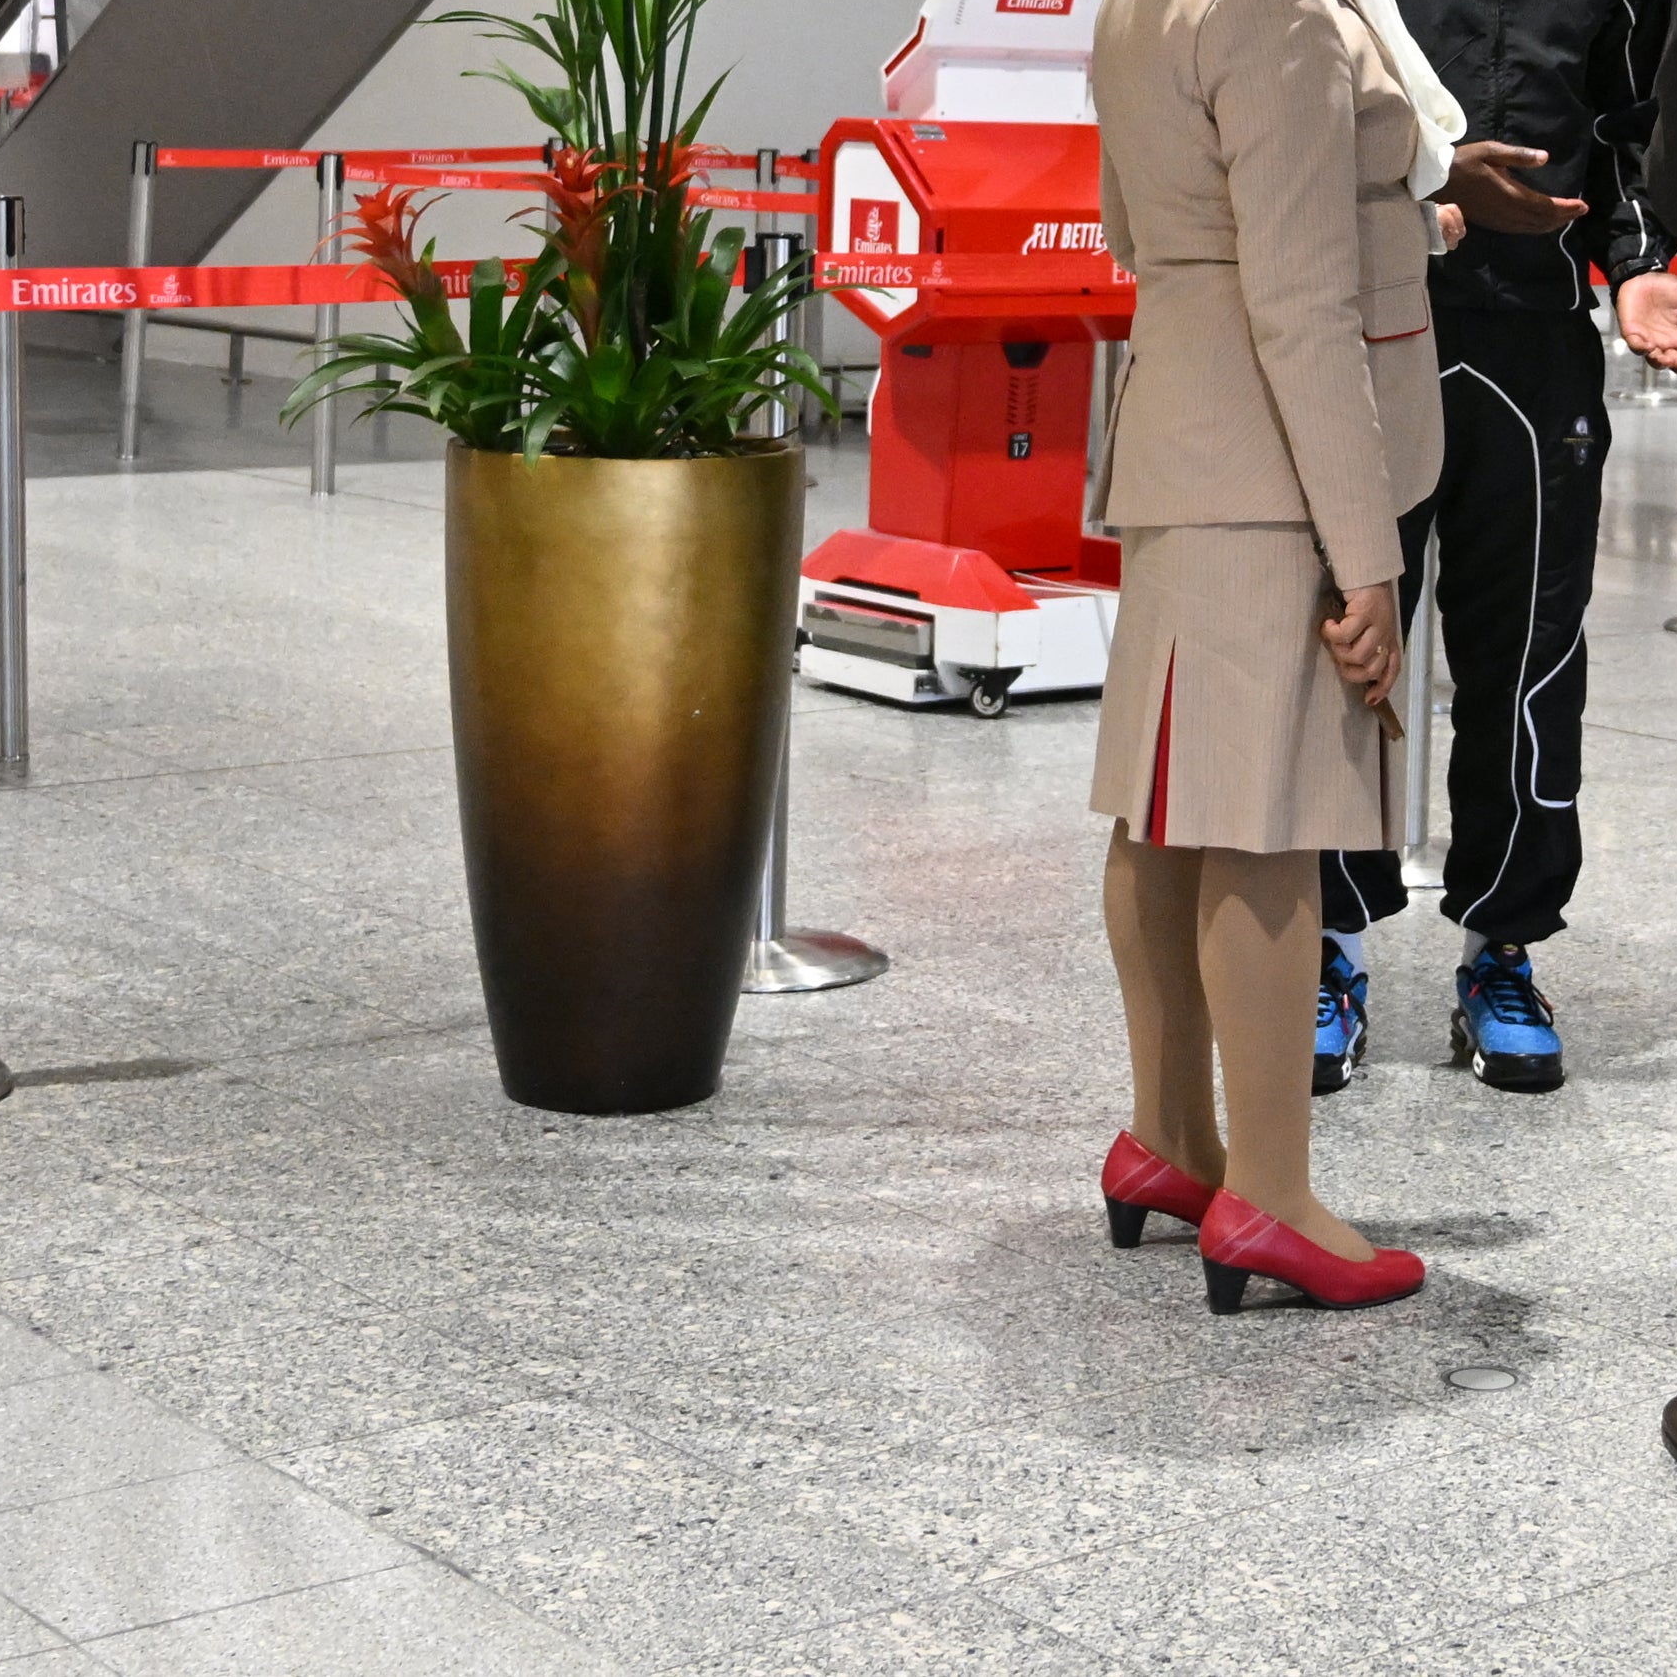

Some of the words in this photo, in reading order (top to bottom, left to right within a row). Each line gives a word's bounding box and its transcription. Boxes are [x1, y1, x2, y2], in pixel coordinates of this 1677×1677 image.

[263, 153, 310, 166] Emirates
[411, 152, 455, 163] Emirates
[694, 157, 728, 167] mirates
[854, 237, 893, 254] Emirates
[1022, 222, 1059, 255] FLY
[1060, 222, 1107, 249] BETTE
[822, 260, 913, 284] Emirates
[12, 277, 137, 305] Emirates
[150, 294, 192, 304] Emirates
[1013, 442, 1029, 457] 17
